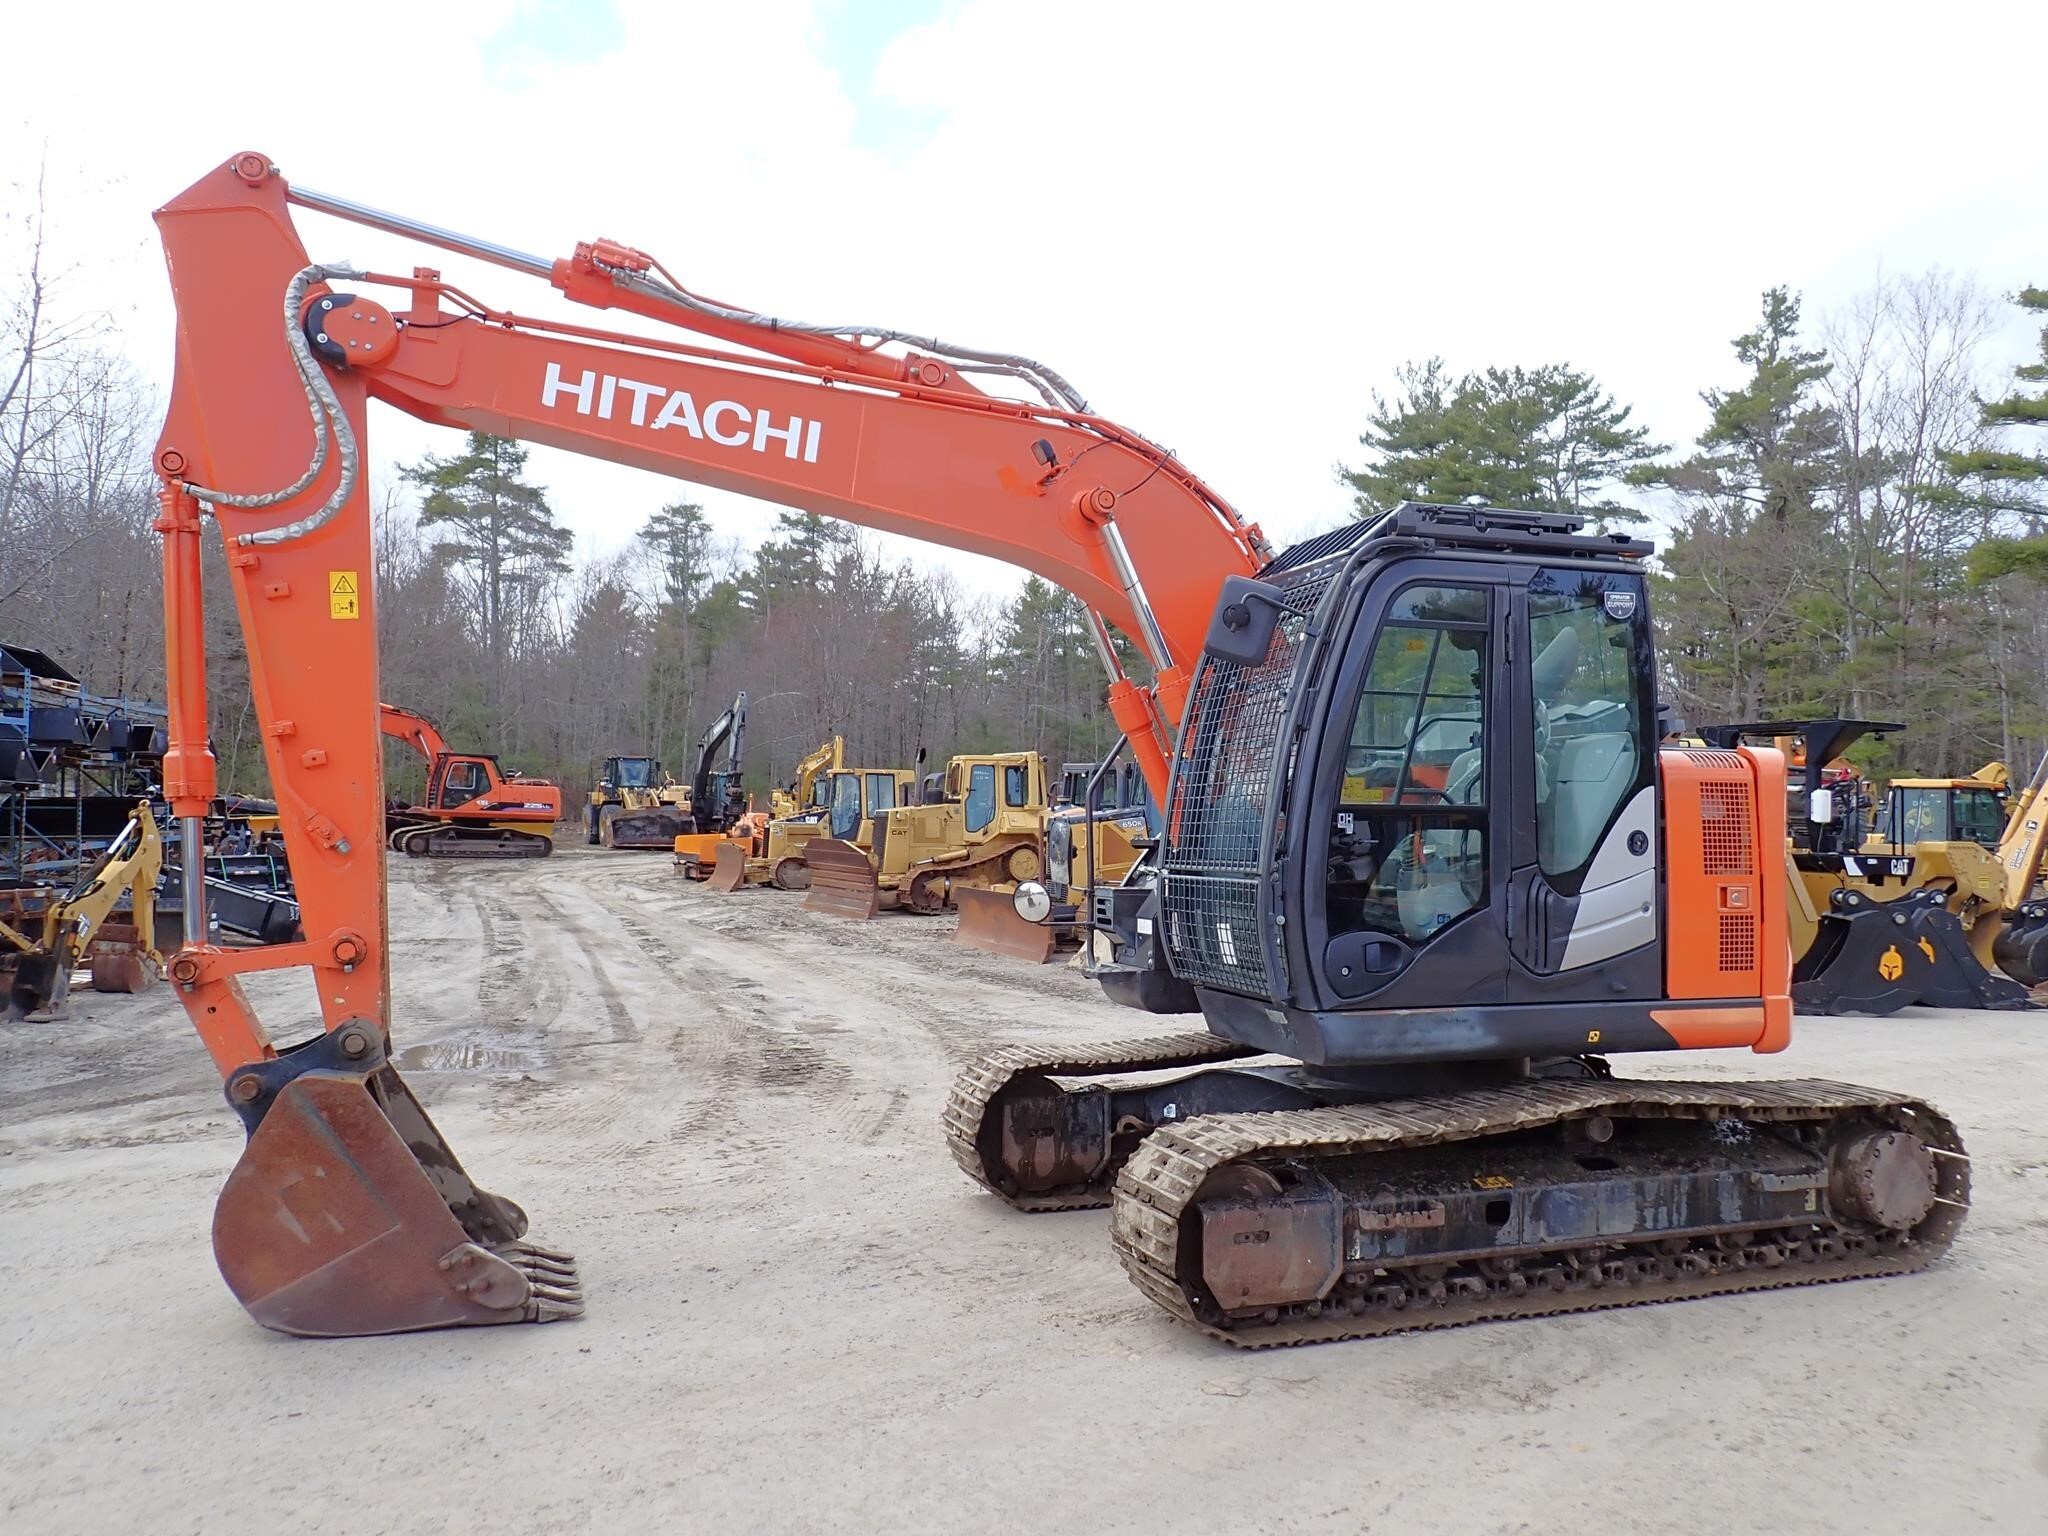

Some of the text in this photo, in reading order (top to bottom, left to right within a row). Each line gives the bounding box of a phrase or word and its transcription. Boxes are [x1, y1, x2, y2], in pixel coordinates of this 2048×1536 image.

[541, 362, 822, 464] HITACHI
[805, 815, 819, 824] CAT
[1122, 820, 1142, 828] 650K
[1891, 858, 1910, 875] CAT
